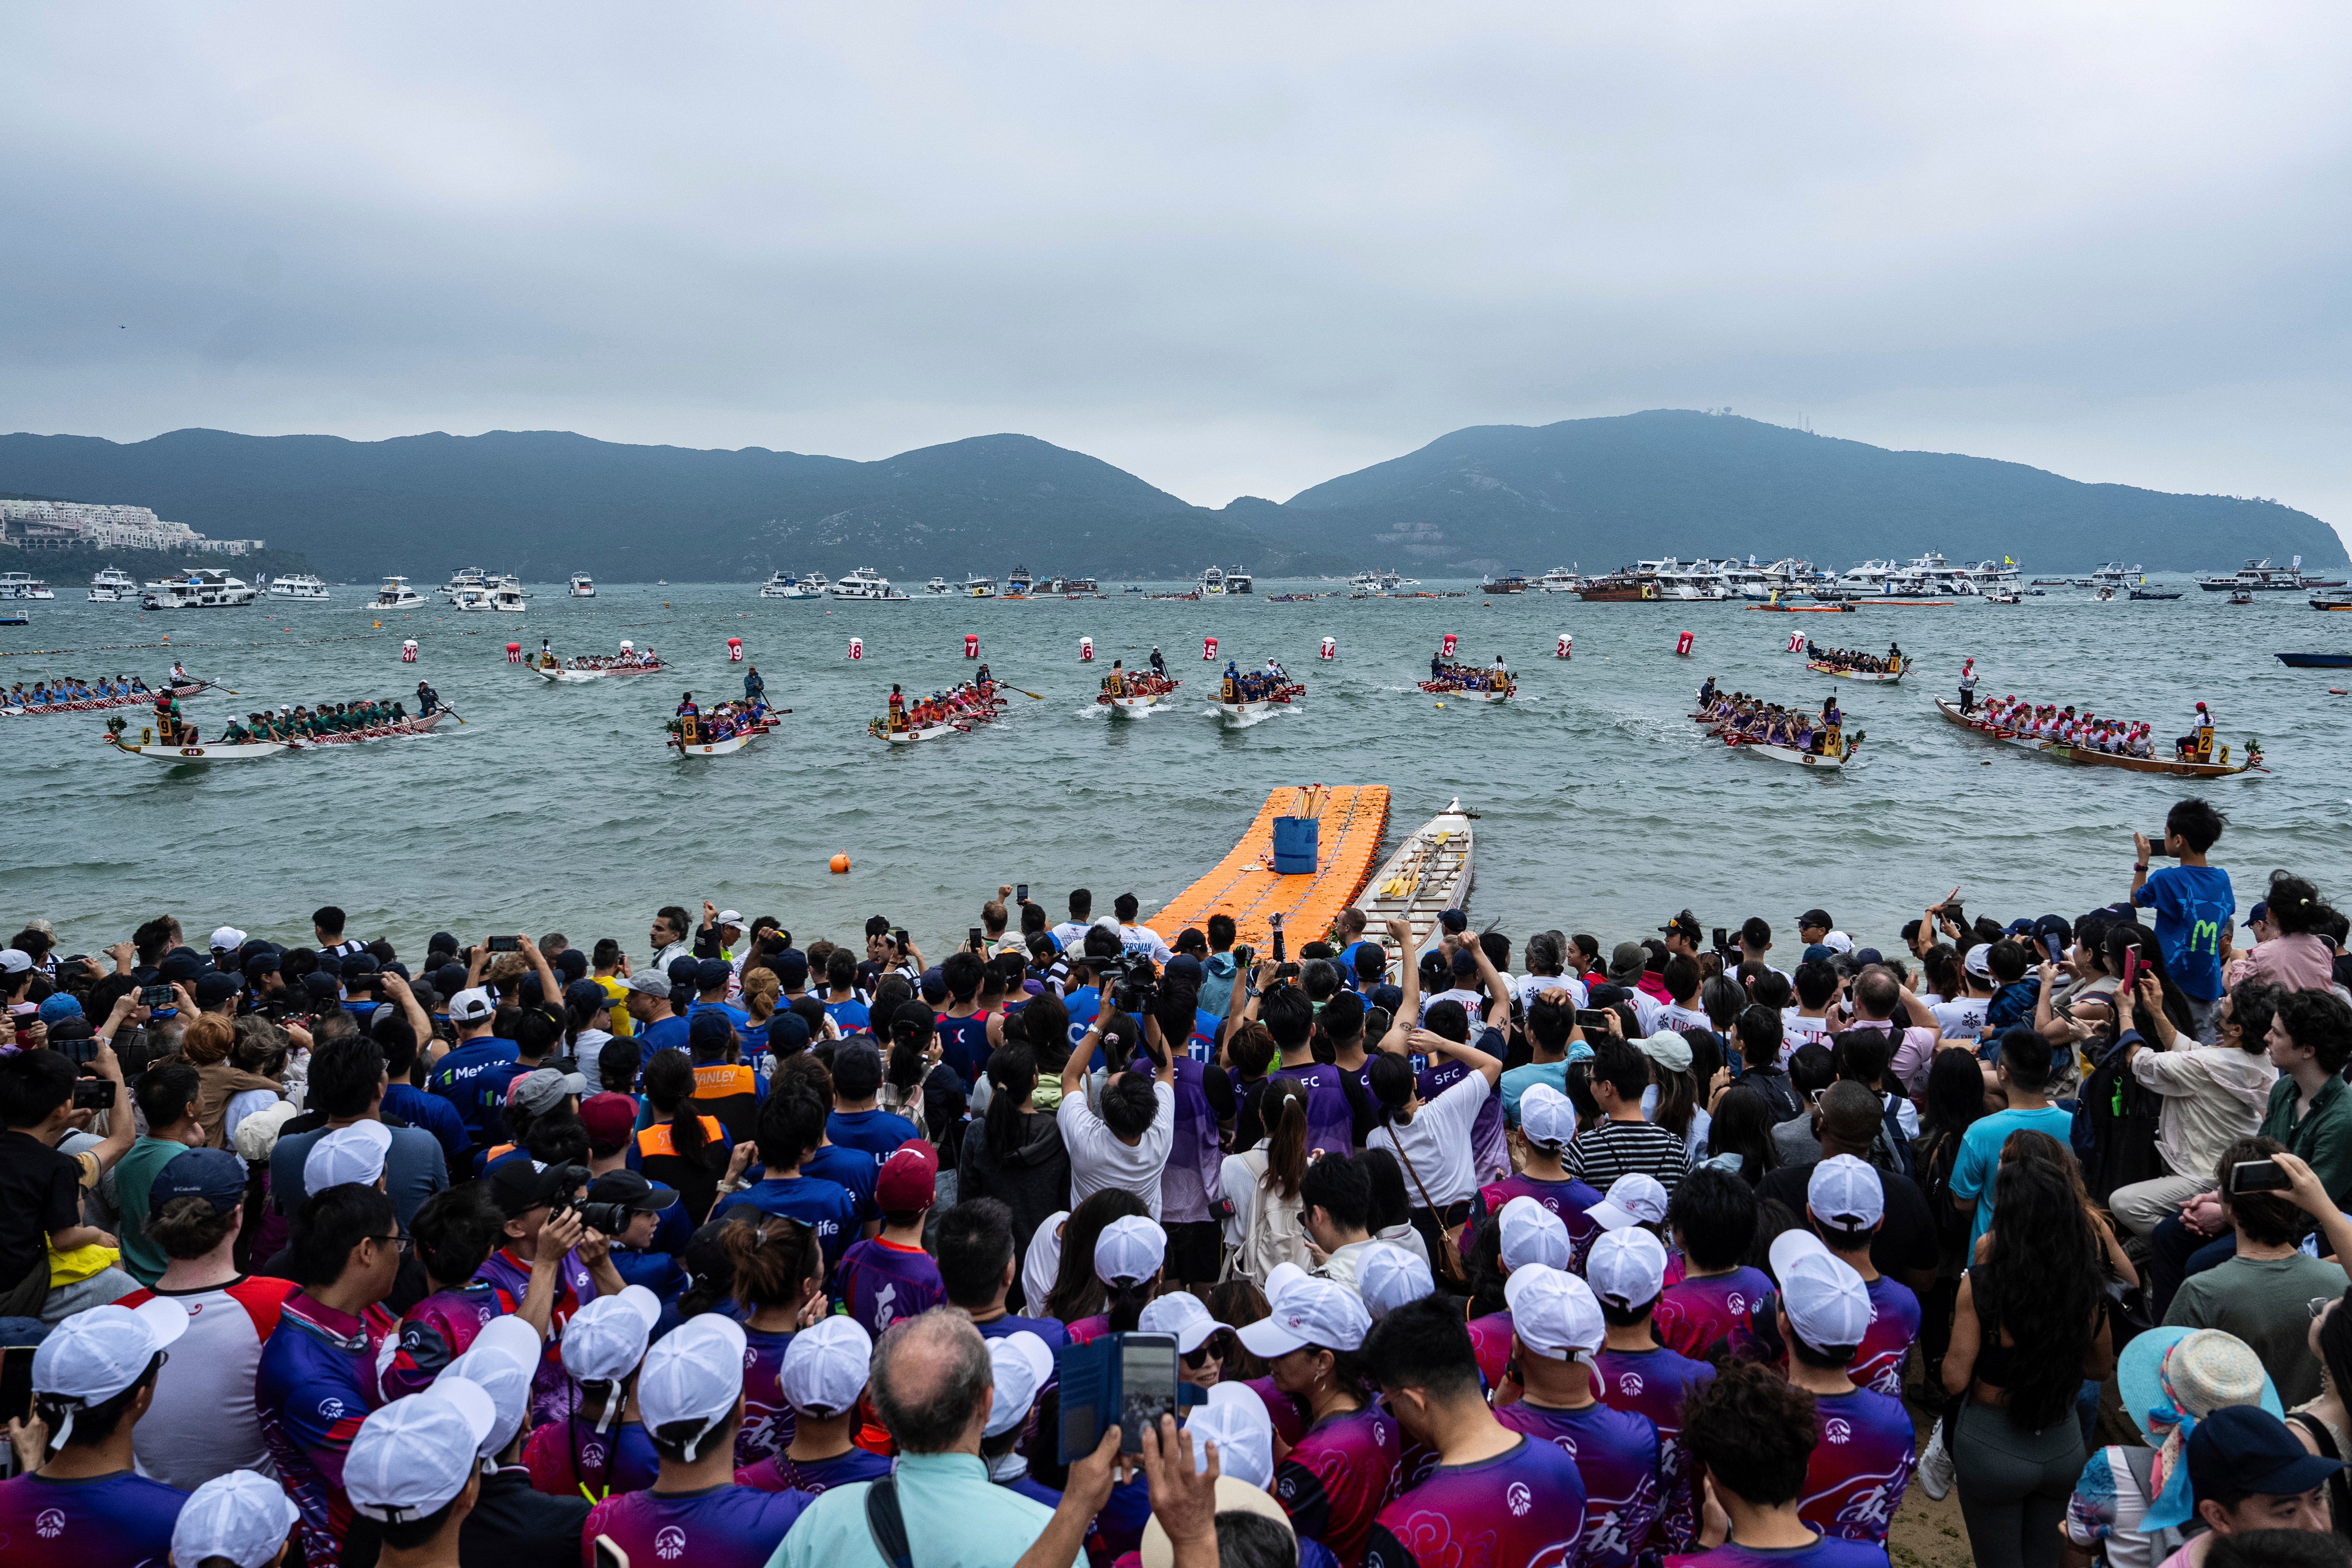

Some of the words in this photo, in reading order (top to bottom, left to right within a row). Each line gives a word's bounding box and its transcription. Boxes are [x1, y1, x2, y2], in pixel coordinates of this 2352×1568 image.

[1788, 636, 1804, 653] 00
[1113, 682, 1119, 693] 6
[1497, 676, 1503, 686] 4
[1225, 684, 1231, 695] 5
[892, 713, 898, 724] 7
[161, 720, 169, 734] 9
[686, 723, 694, 736] 8
[143, 729, 150, 745] 9
[1828, 733, 1836, 746] 3
[2201, 736, 2210, 750] 2
[1837, 742, 1842, 757] 3
[2219, 748, 2228, 764] 2
[1434, 1068, 1460, 1085] SFC
[1731, 1307, 1745, 1316] AIA
[1621, 1387, 1642, 1397] AIA
[1828, 1434, 1850, 1445] AIA
[582, 1458, 602, 1468] AIA
[1513, 1501, 1532, 1517] AIA
[36, 1526, 62, 1539] AIA
[656, 1547, 683, 1560] AIA
